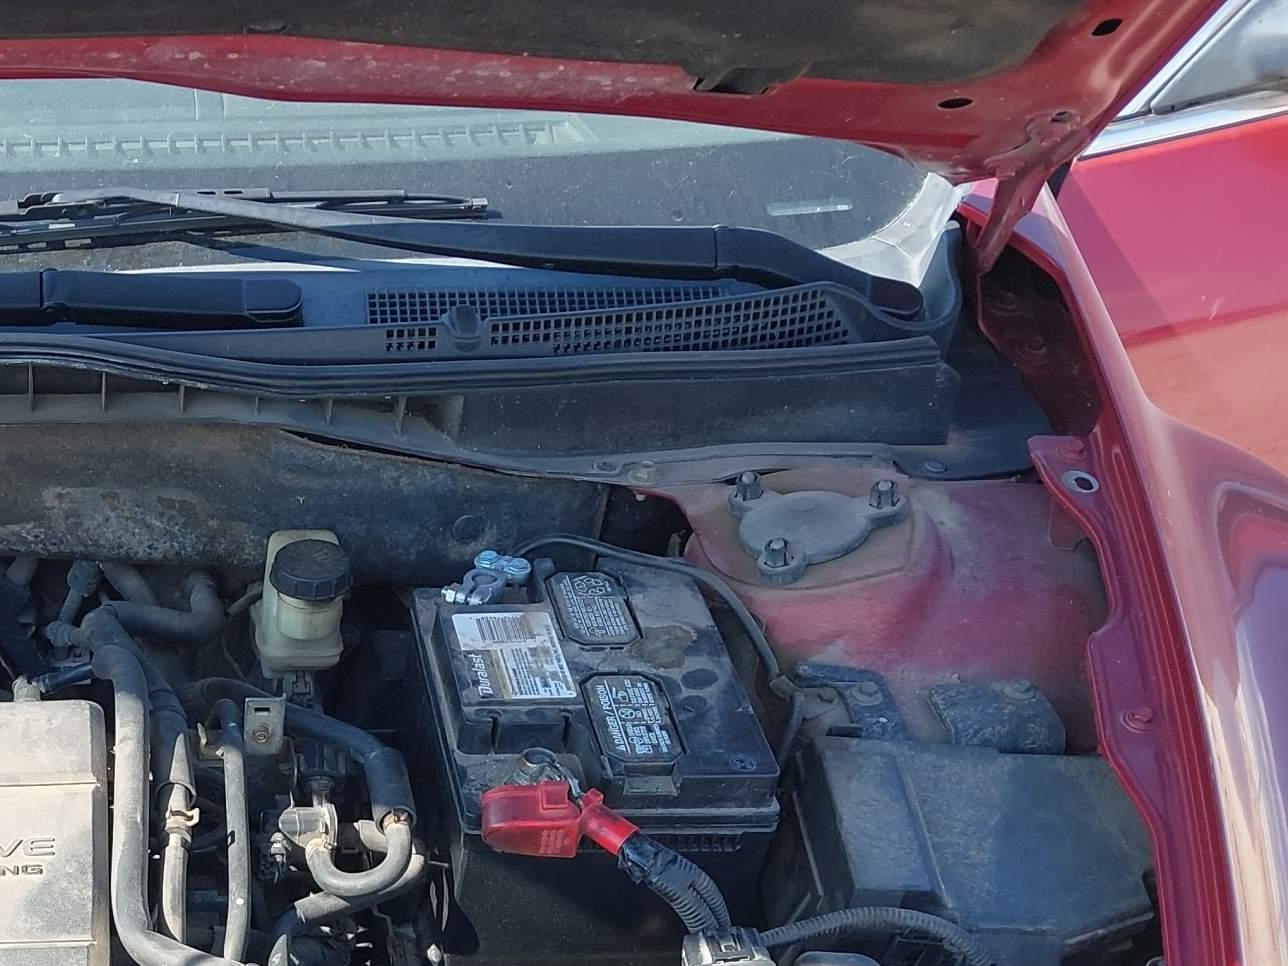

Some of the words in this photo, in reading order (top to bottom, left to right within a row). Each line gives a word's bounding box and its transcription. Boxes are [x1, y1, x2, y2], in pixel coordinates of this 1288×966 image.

[468, 653, 494, 697] Duralast
[595, 684, 613, 710] POISON
[606, 716, 625, 744] DANGER
